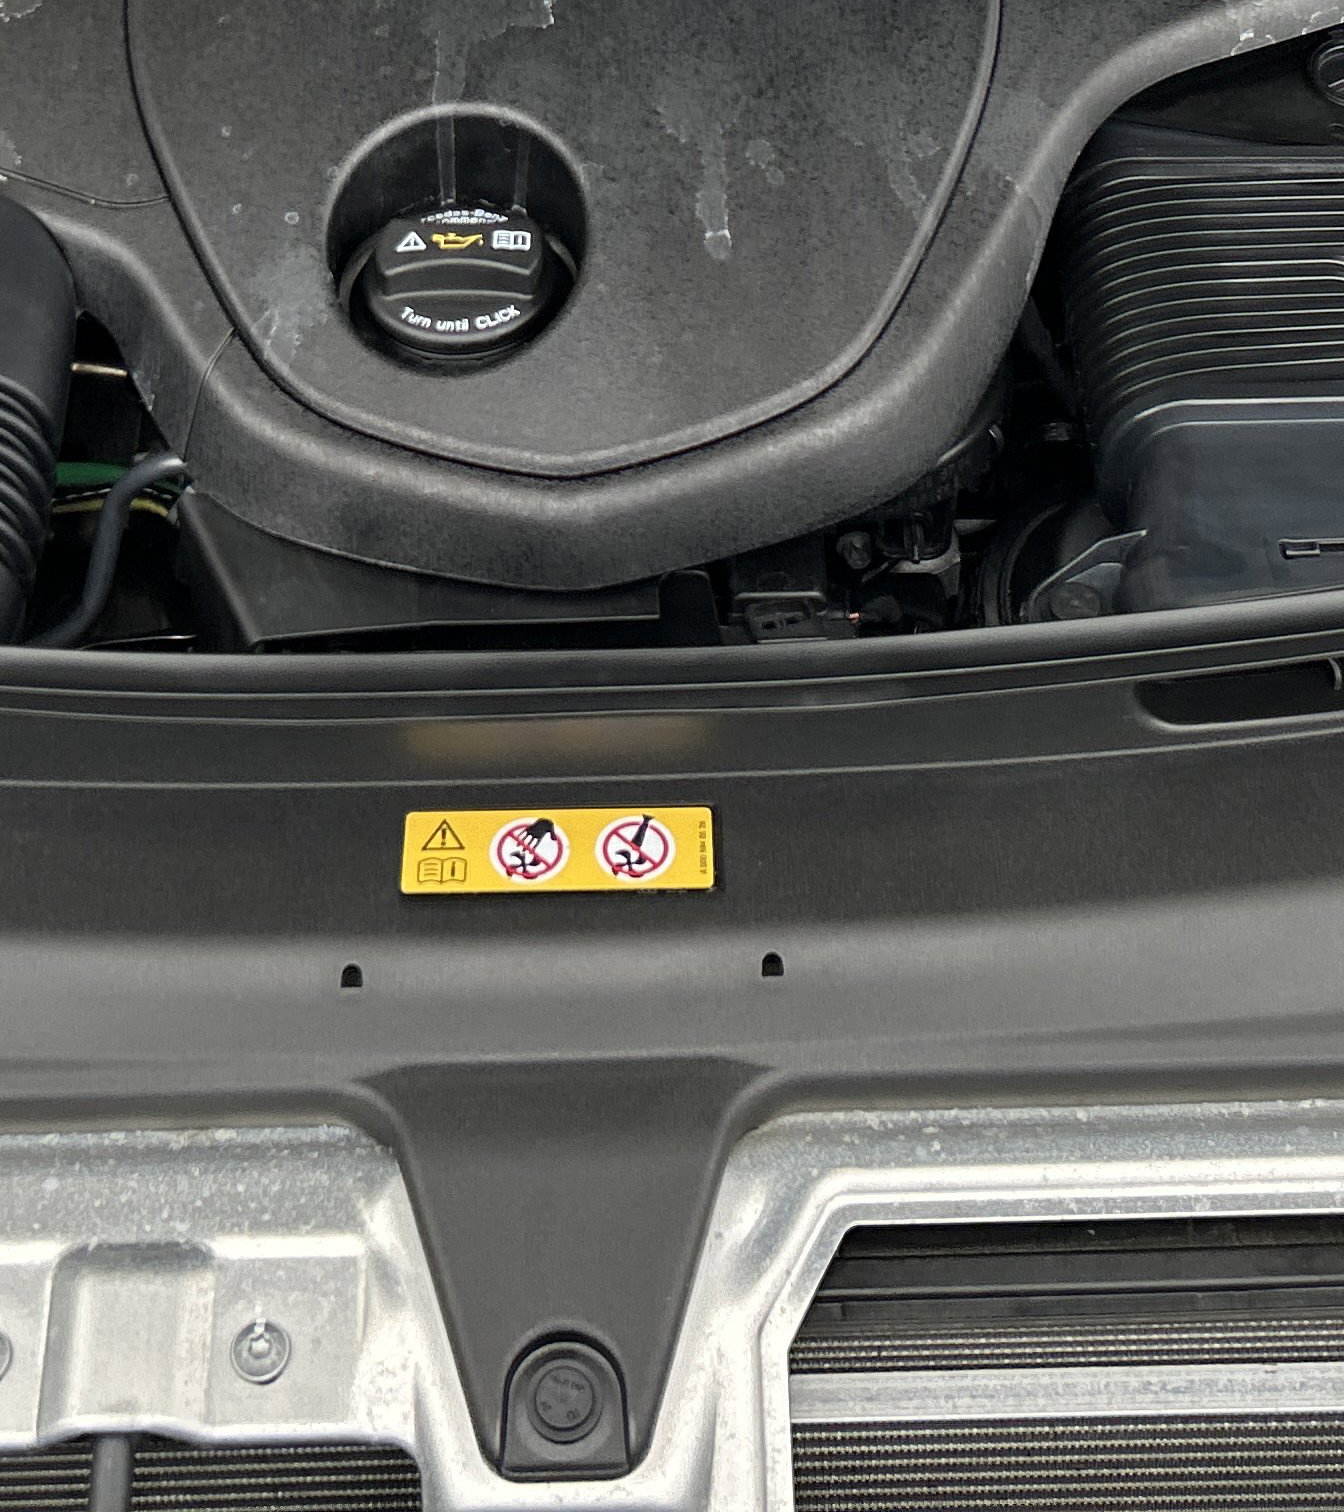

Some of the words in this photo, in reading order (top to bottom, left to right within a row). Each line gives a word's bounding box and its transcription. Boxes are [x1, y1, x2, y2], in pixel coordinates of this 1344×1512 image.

[401, 306, 432, 328] Turn
[436, 317, 469, 332] until
[475, 304, 521, 330] CLICK
